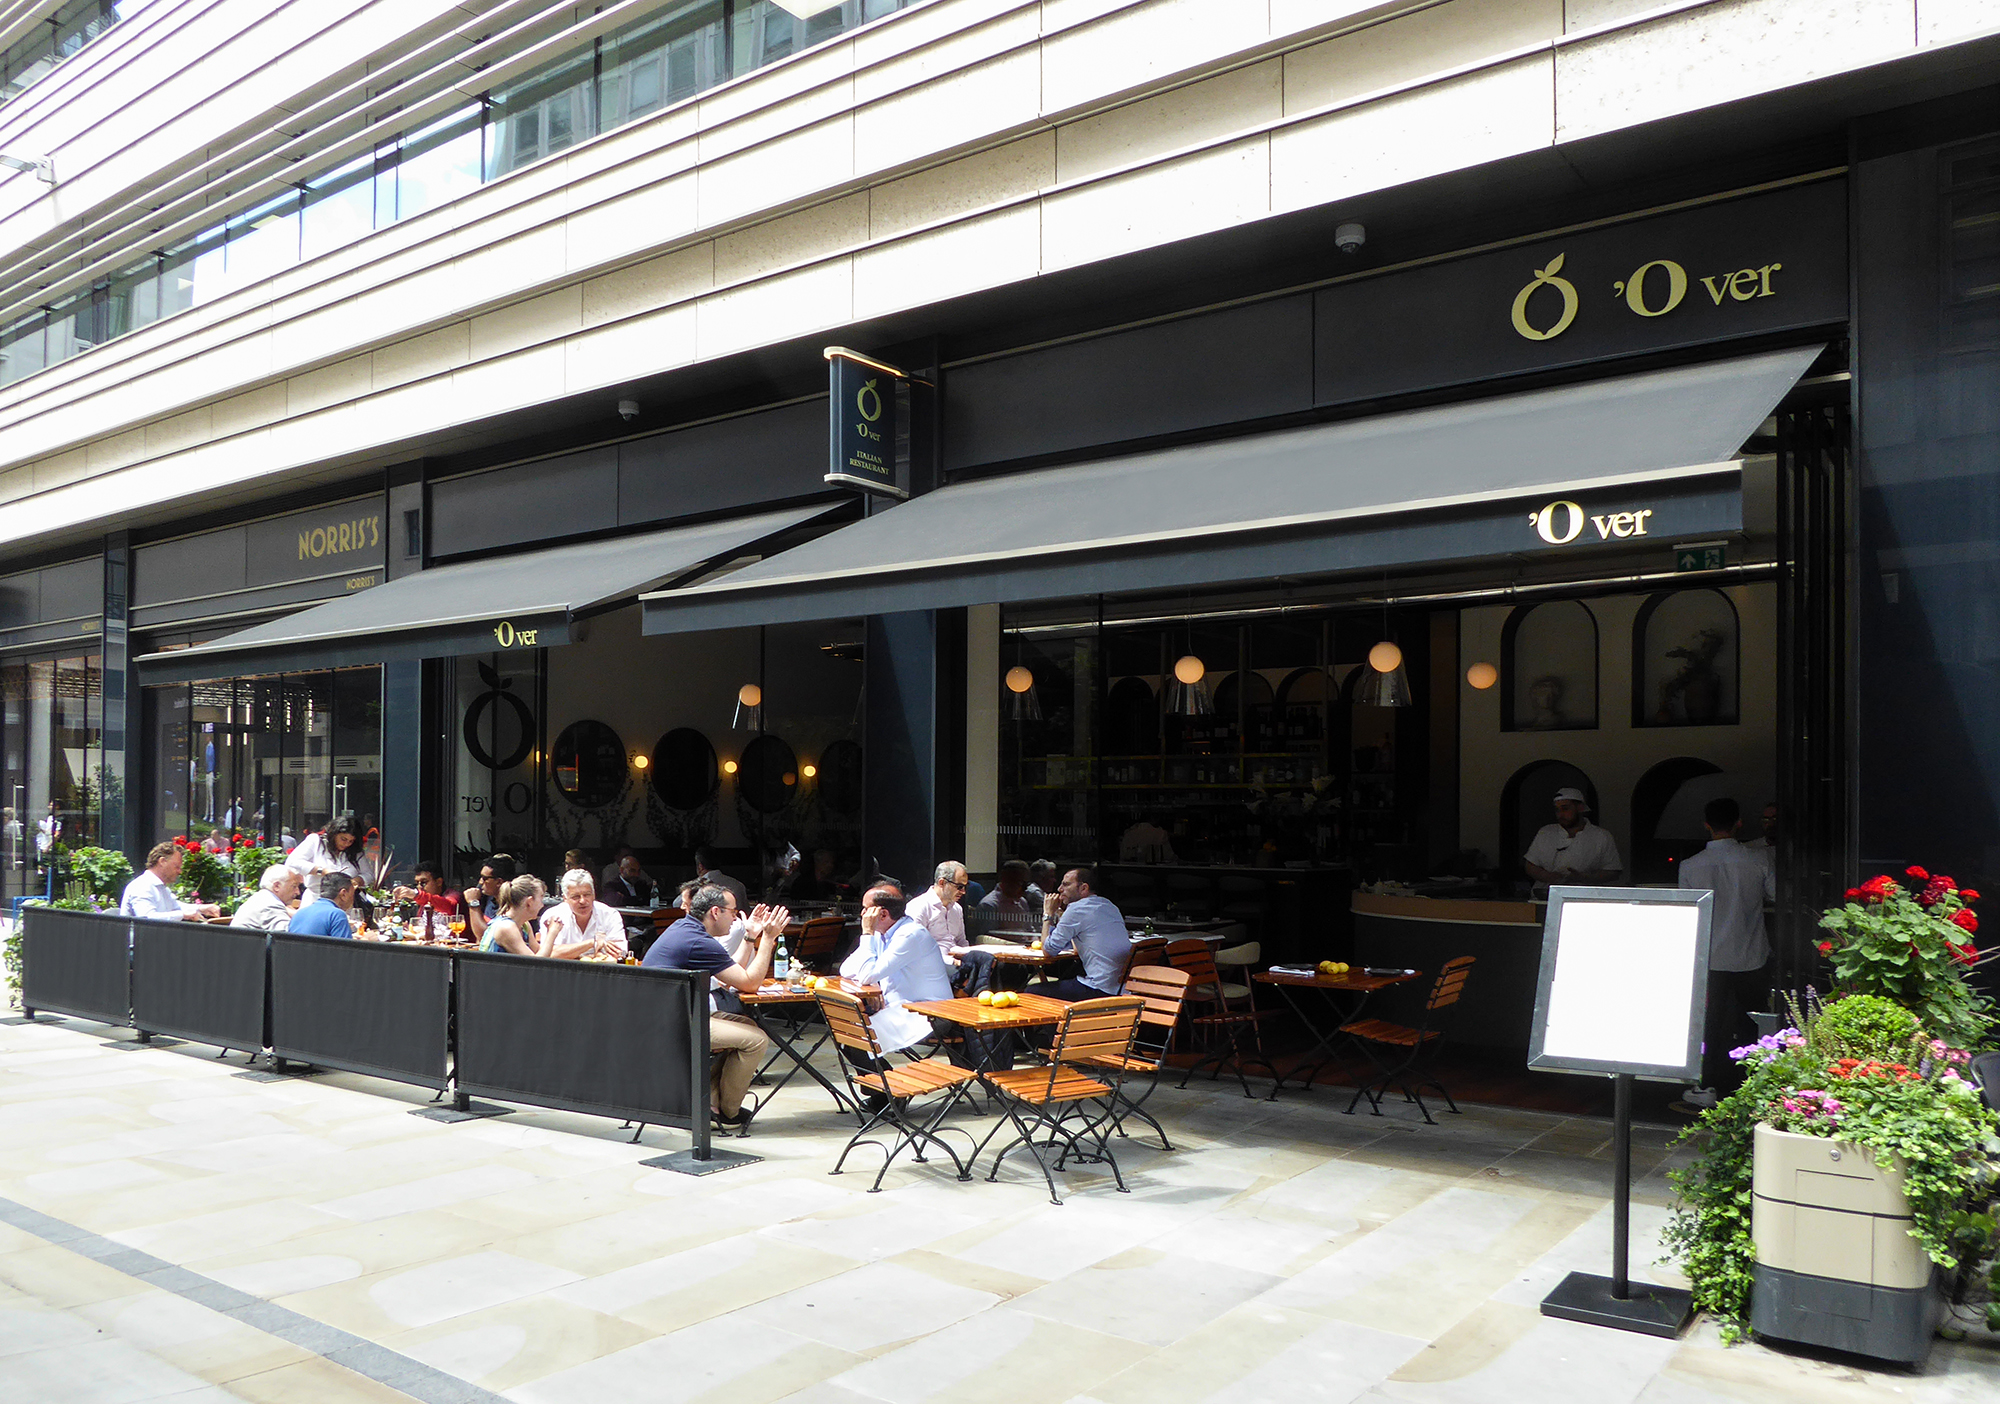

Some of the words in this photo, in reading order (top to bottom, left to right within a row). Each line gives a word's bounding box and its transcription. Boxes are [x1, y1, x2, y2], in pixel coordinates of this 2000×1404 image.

[1699, 262, 1782, 306] ver
[849, 458, 890, 476] RESTAURANT
[856, 450, 883, 464] ITALIAN
[1591, 509, 1652, 540] ver
[298, 515, 379, 561] NORRIS'S
[515, 629, 538, 646] ver
